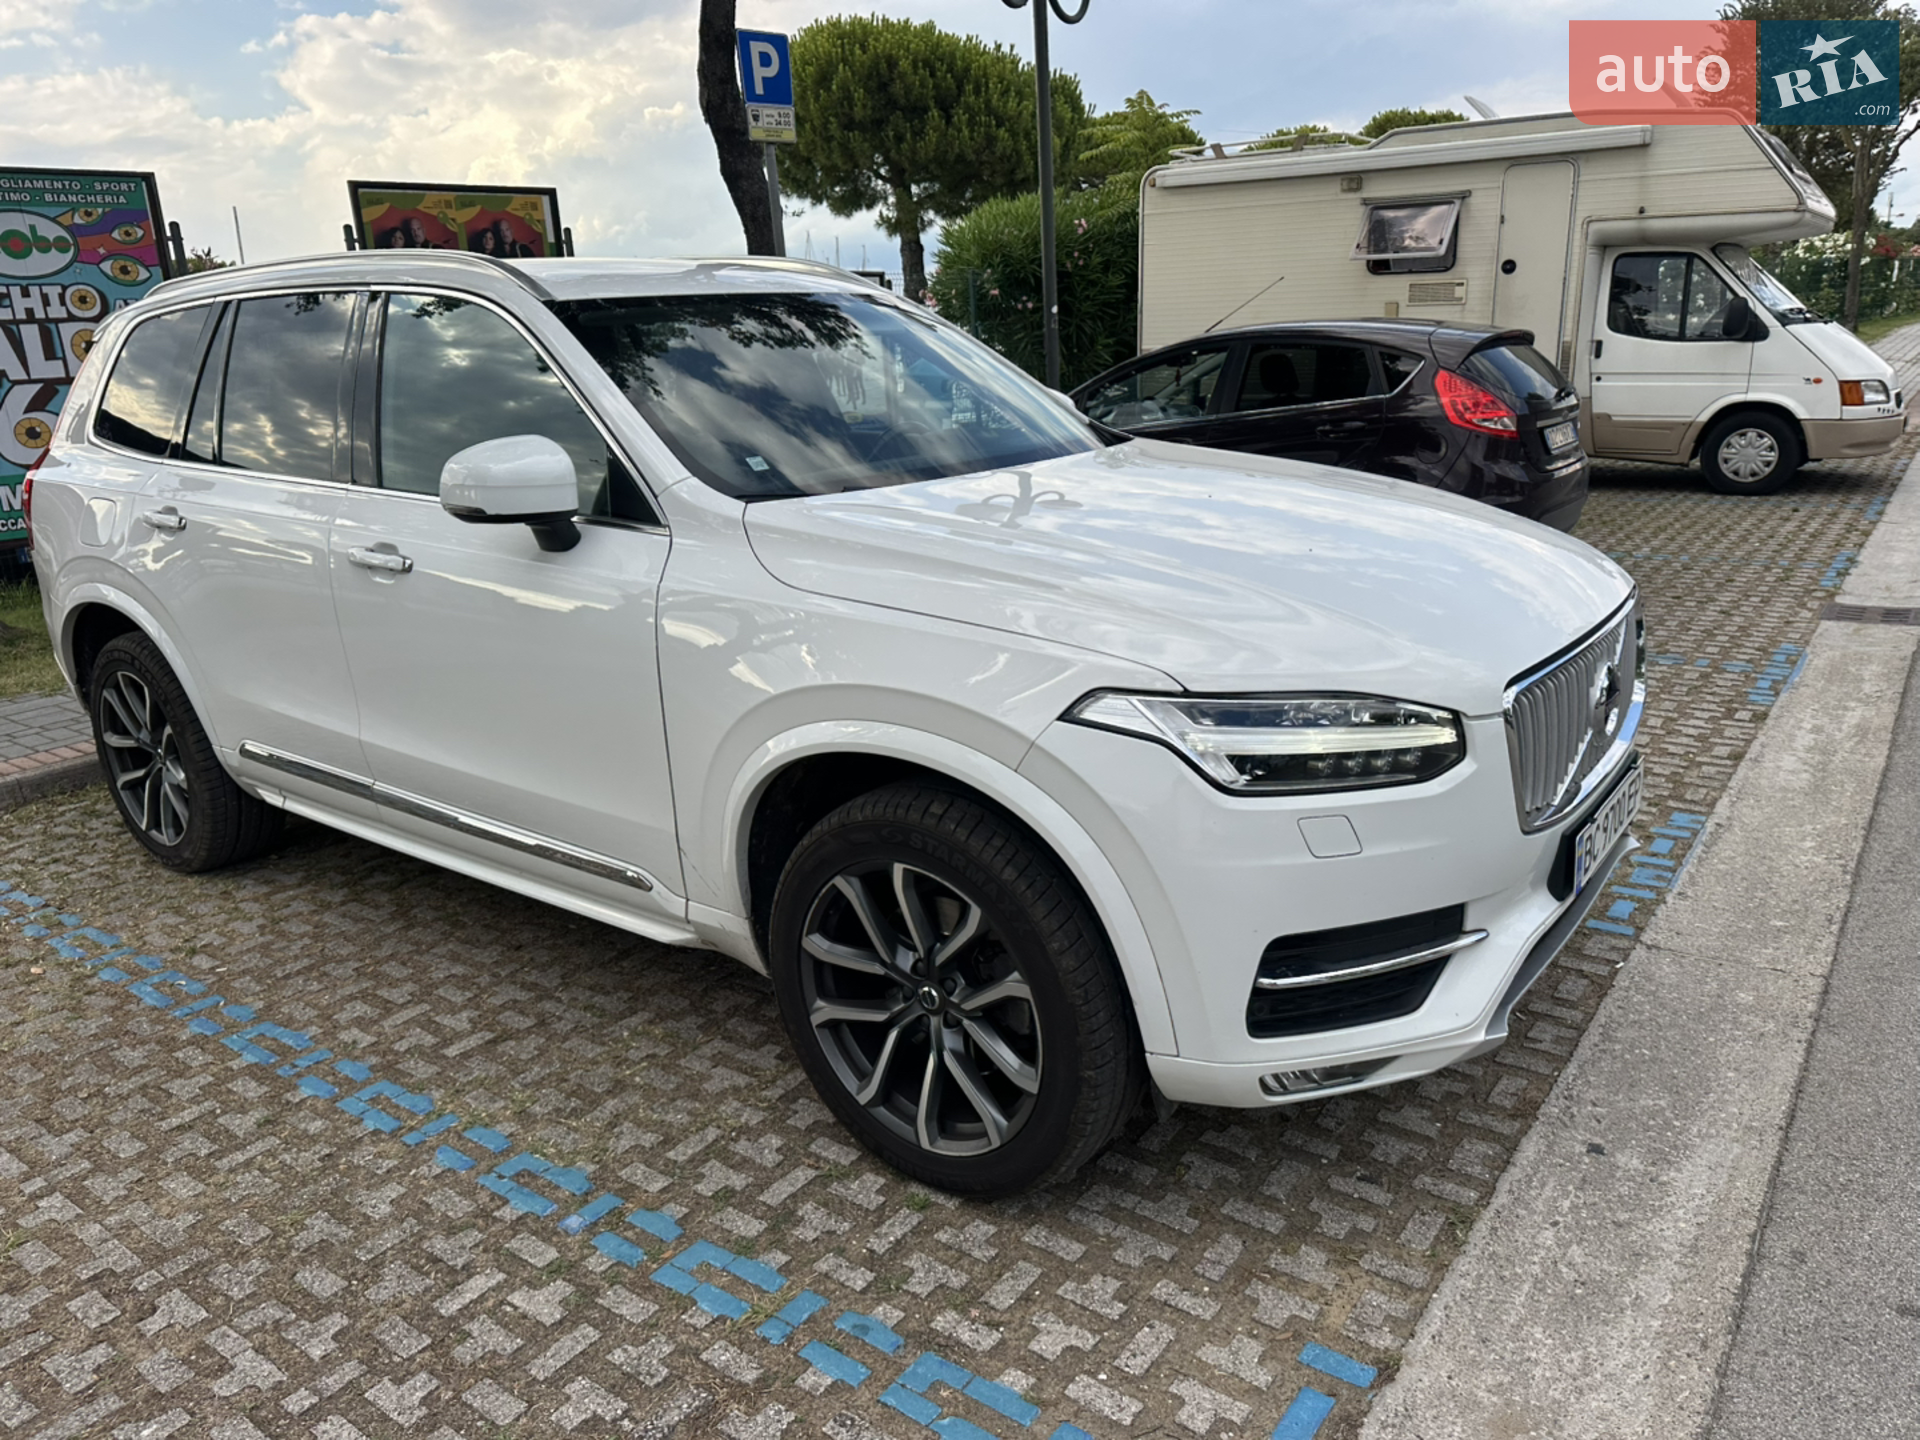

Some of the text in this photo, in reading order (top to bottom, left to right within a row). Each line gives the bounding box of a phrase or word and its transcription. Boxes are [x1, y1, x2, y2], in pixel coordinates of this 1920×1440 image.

[749, 40, 780, 95] P
[0, 178, 136, 192] GLIAMENTO SPORT
[44, 192, 128, 205] BIANCHERIA
